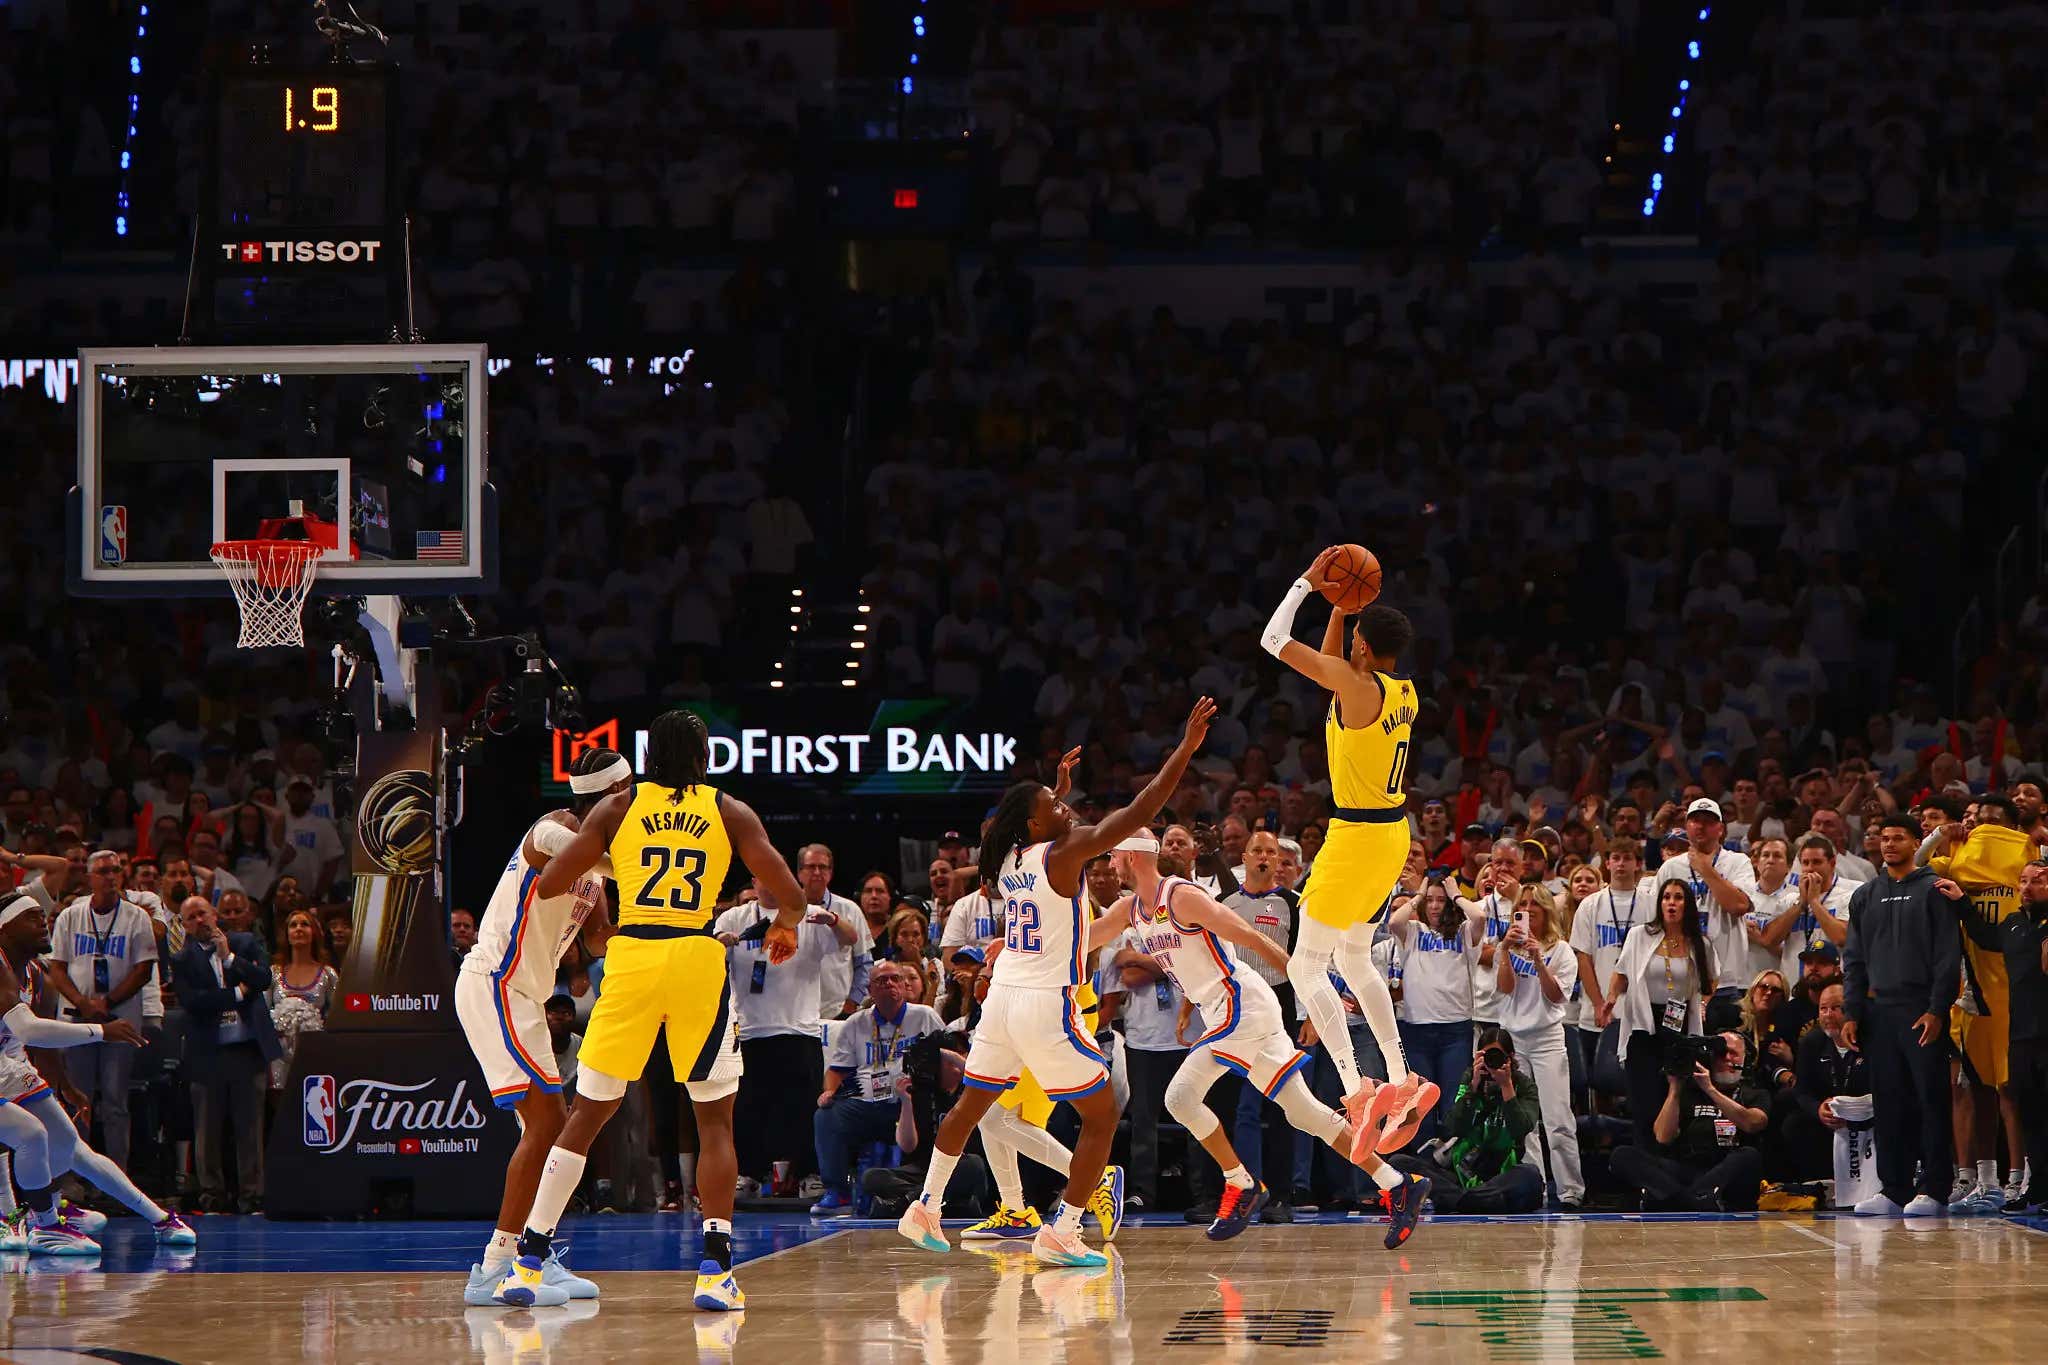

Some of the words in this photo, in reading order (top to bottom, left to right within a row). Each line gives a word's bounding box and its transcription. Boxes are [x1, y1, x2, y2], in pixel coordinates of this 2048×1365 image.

[285, 87, 338, 131] 1.9
[265, 240, 381, 262] TISSOT
[1386, 740, 1408, 795] 0
[641, 812, 711, 840] NESMITH
[635, 846, 707, 912] 23
[1001, 872, 1037, 893] WALLACE
[1005, 897, 1042, 954] 22
[371, 994, 421, 1011] YouTube
[422, 994, 440, 1011] TV
[320, 1077, 487, 1154] Finals
[308, 1130, 323, 1142] NBA
[356, 1142, 387, 1154] Presented
[388, 1142, 396, 1155] by
[421, 1139, 463, 1153] YouTube
[464, 1138, 479, 1153] TV
